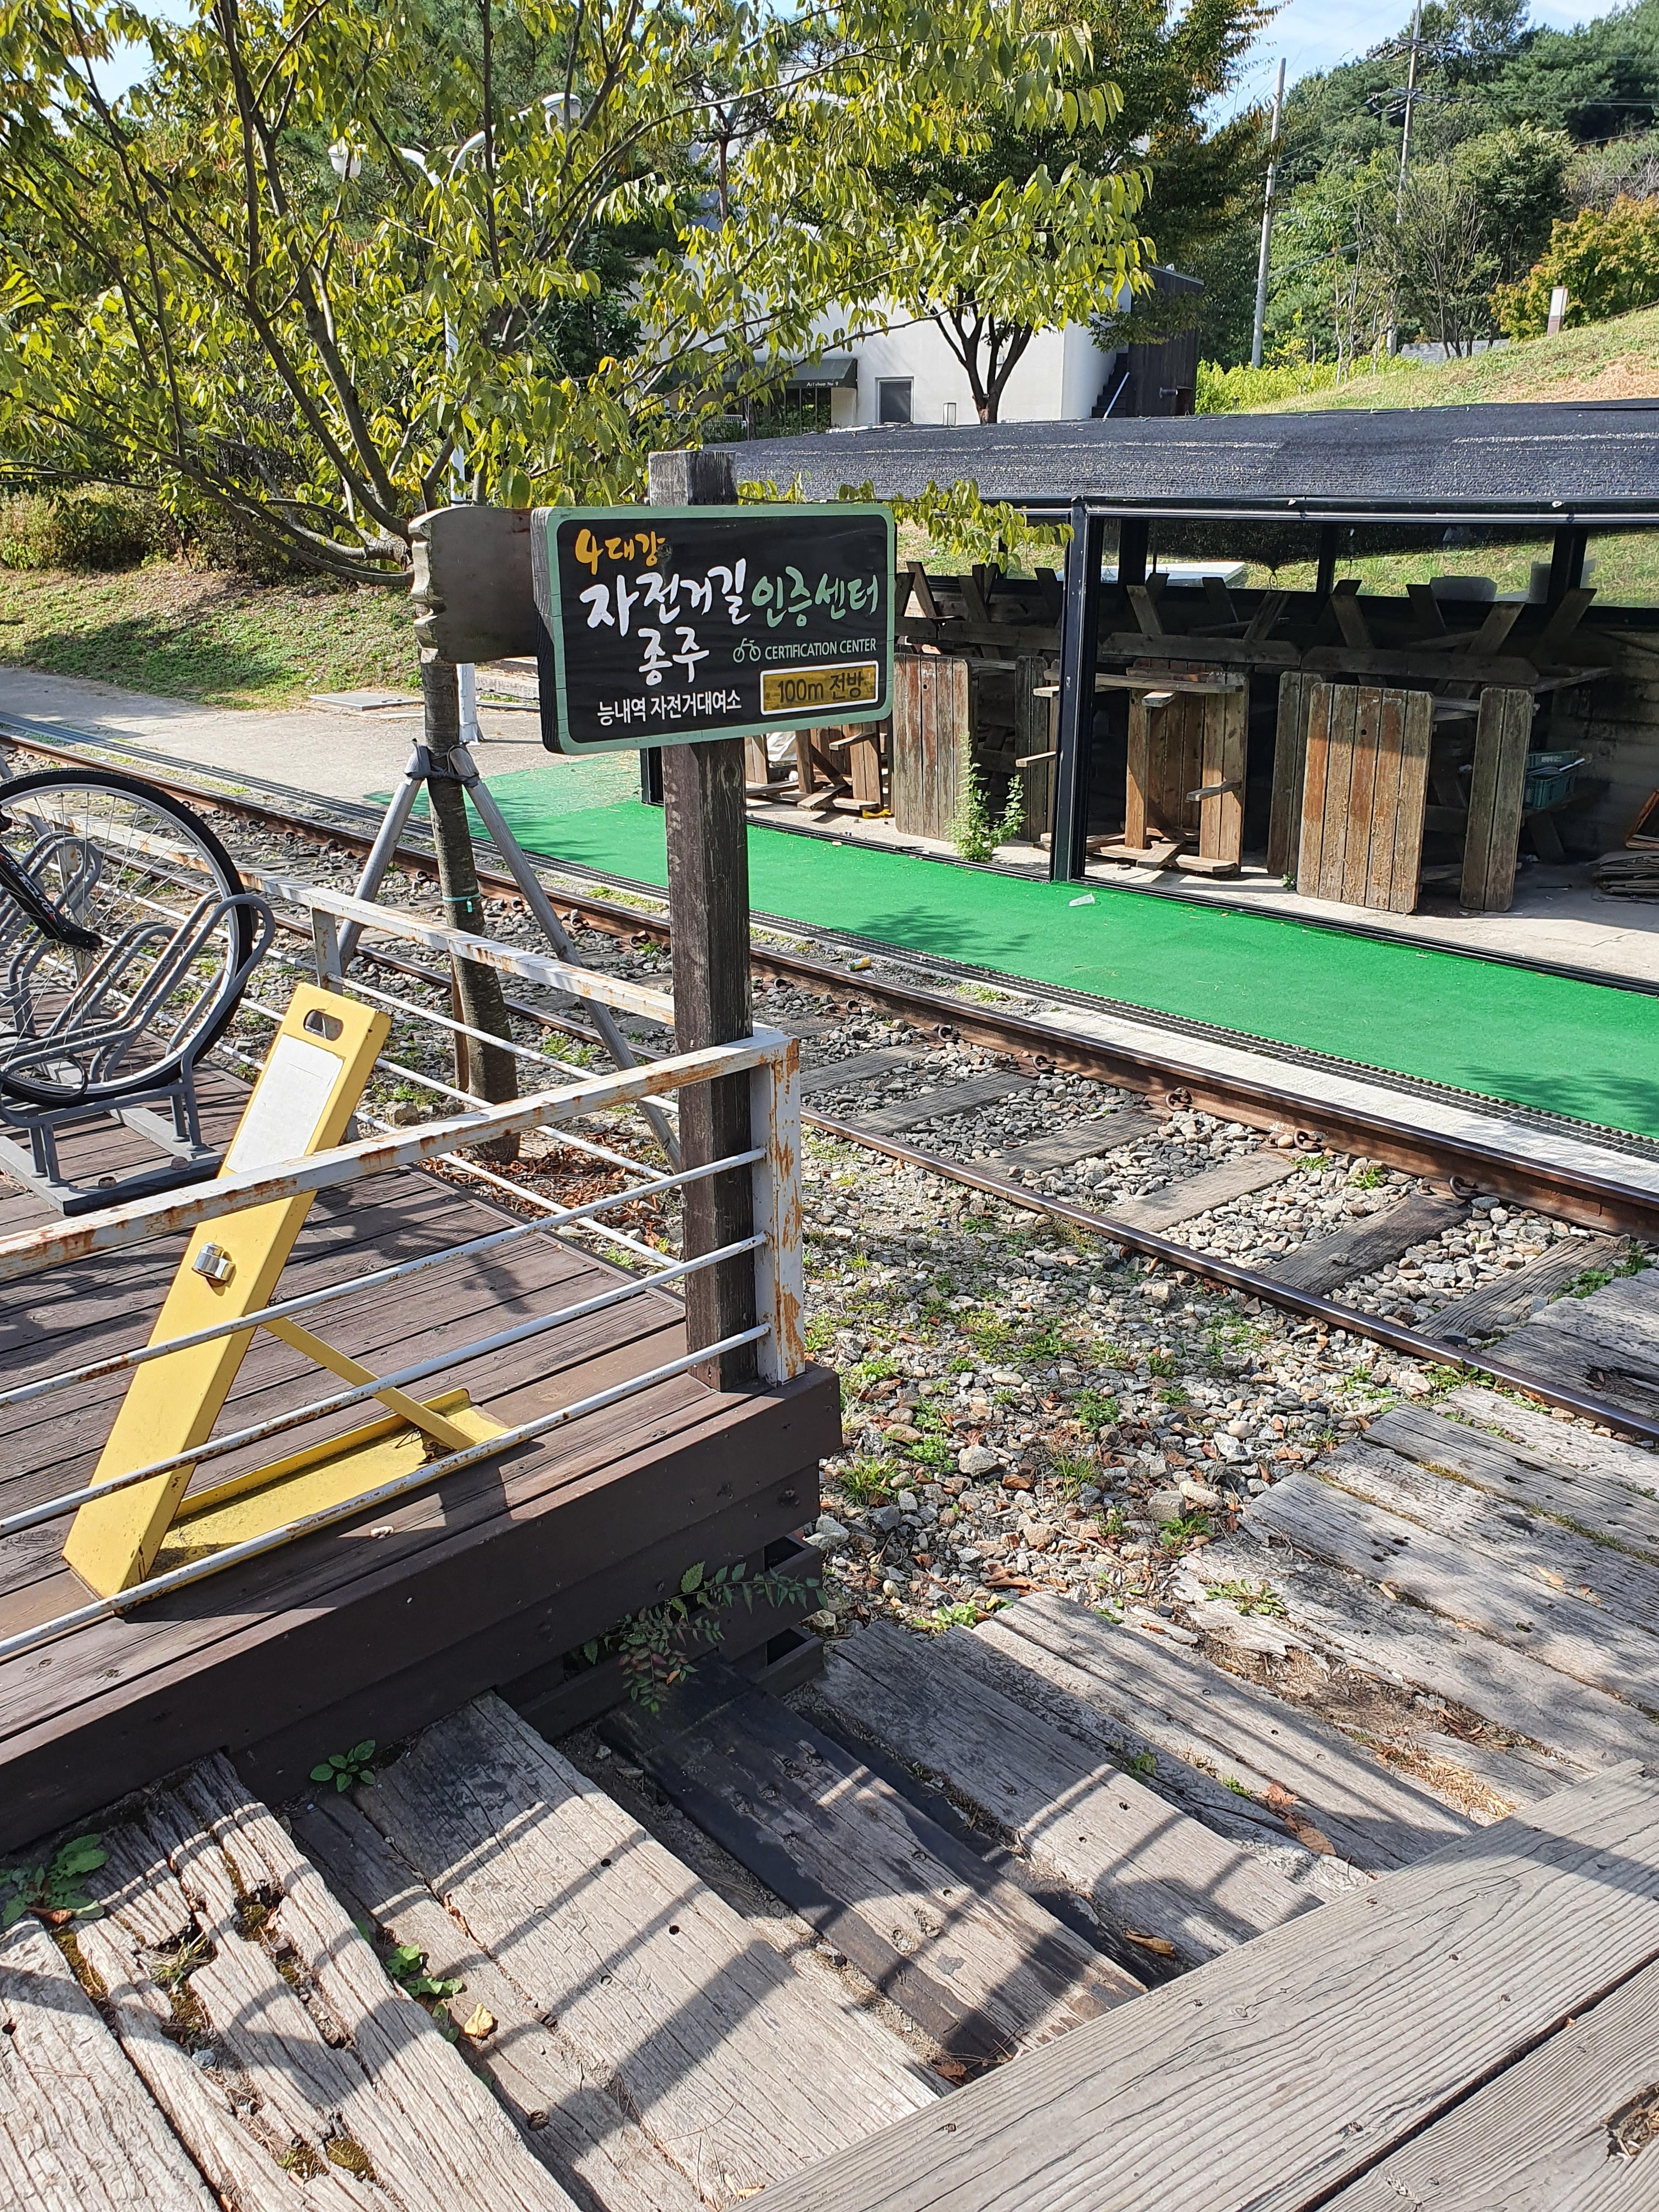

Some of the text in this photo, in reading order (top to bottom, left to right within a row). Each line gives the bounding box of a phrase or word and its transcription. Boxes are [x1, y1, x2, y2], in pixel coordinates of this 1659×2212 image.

[575, 528, 666, 575] 4대강
[579, 558, 878, 637] 자전거길 인증센터
[638, 626, 710, 686] 종주
[764, 637, 877, 660] CERTIFICATION CENTER
[597, 689, 742, 726] 능내역 자전거대여소
[777, 670, 864, 703] 100m 전방
